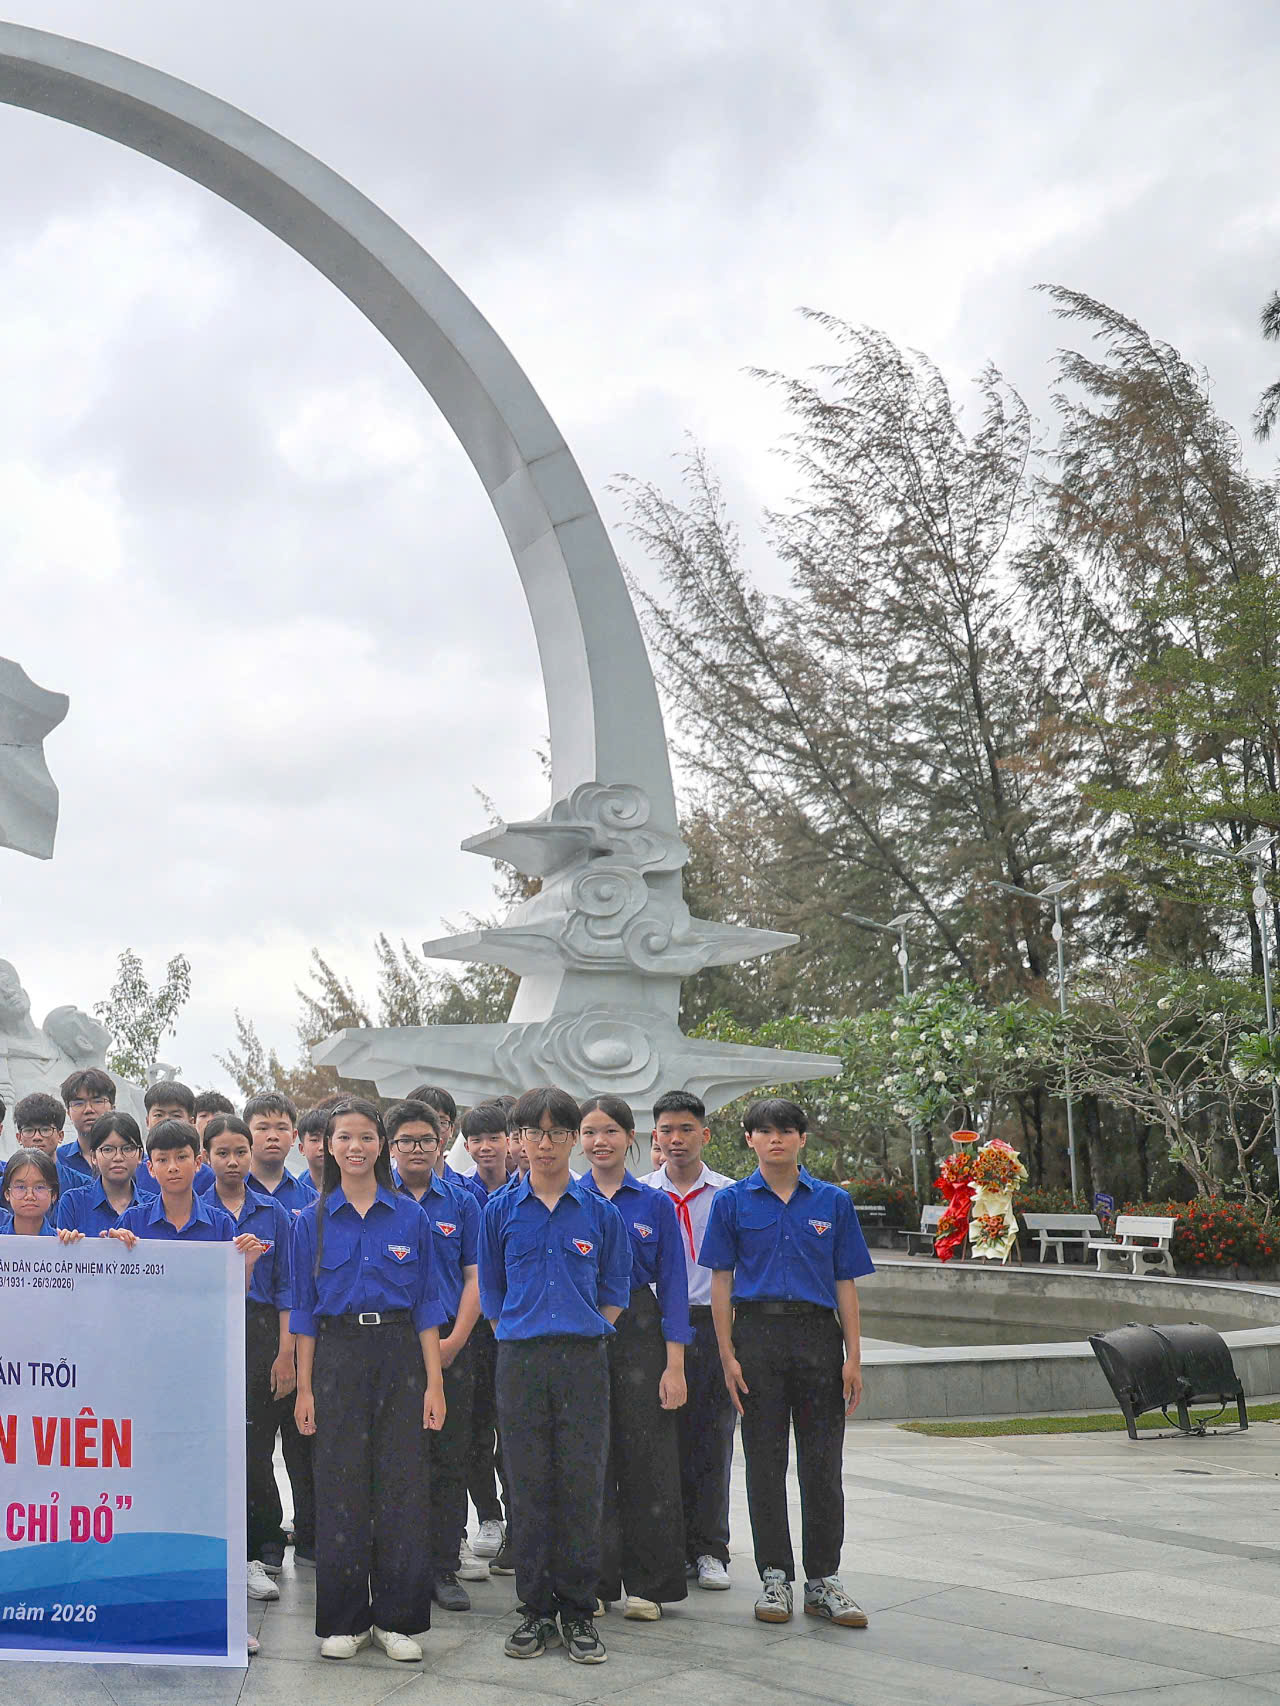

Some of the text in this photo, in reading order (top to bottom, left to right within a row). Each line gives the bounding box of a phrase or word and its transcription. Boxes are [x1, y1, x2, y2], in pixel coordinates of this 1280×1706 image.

[12, 1259, 31, 1273] DÂN
[33, 1259, 52, 1273] CÁC
[54, 1259, 73, 1273] CẤP
[75, 1262, 104, 1276] NHIỆM
[120, 1263, 140, 1275] 2025
[32, 1277, 75, 1291] 26/3/2026)
[28, 1357, 76, 1388] TRỖI
[32, 1406, 132, 1468] VIÊN
[6, 1491, 60, 1543] CHỈ
[2, 1602, 45, 1621] năm
[51, 1603, 97, 1623] 2026
